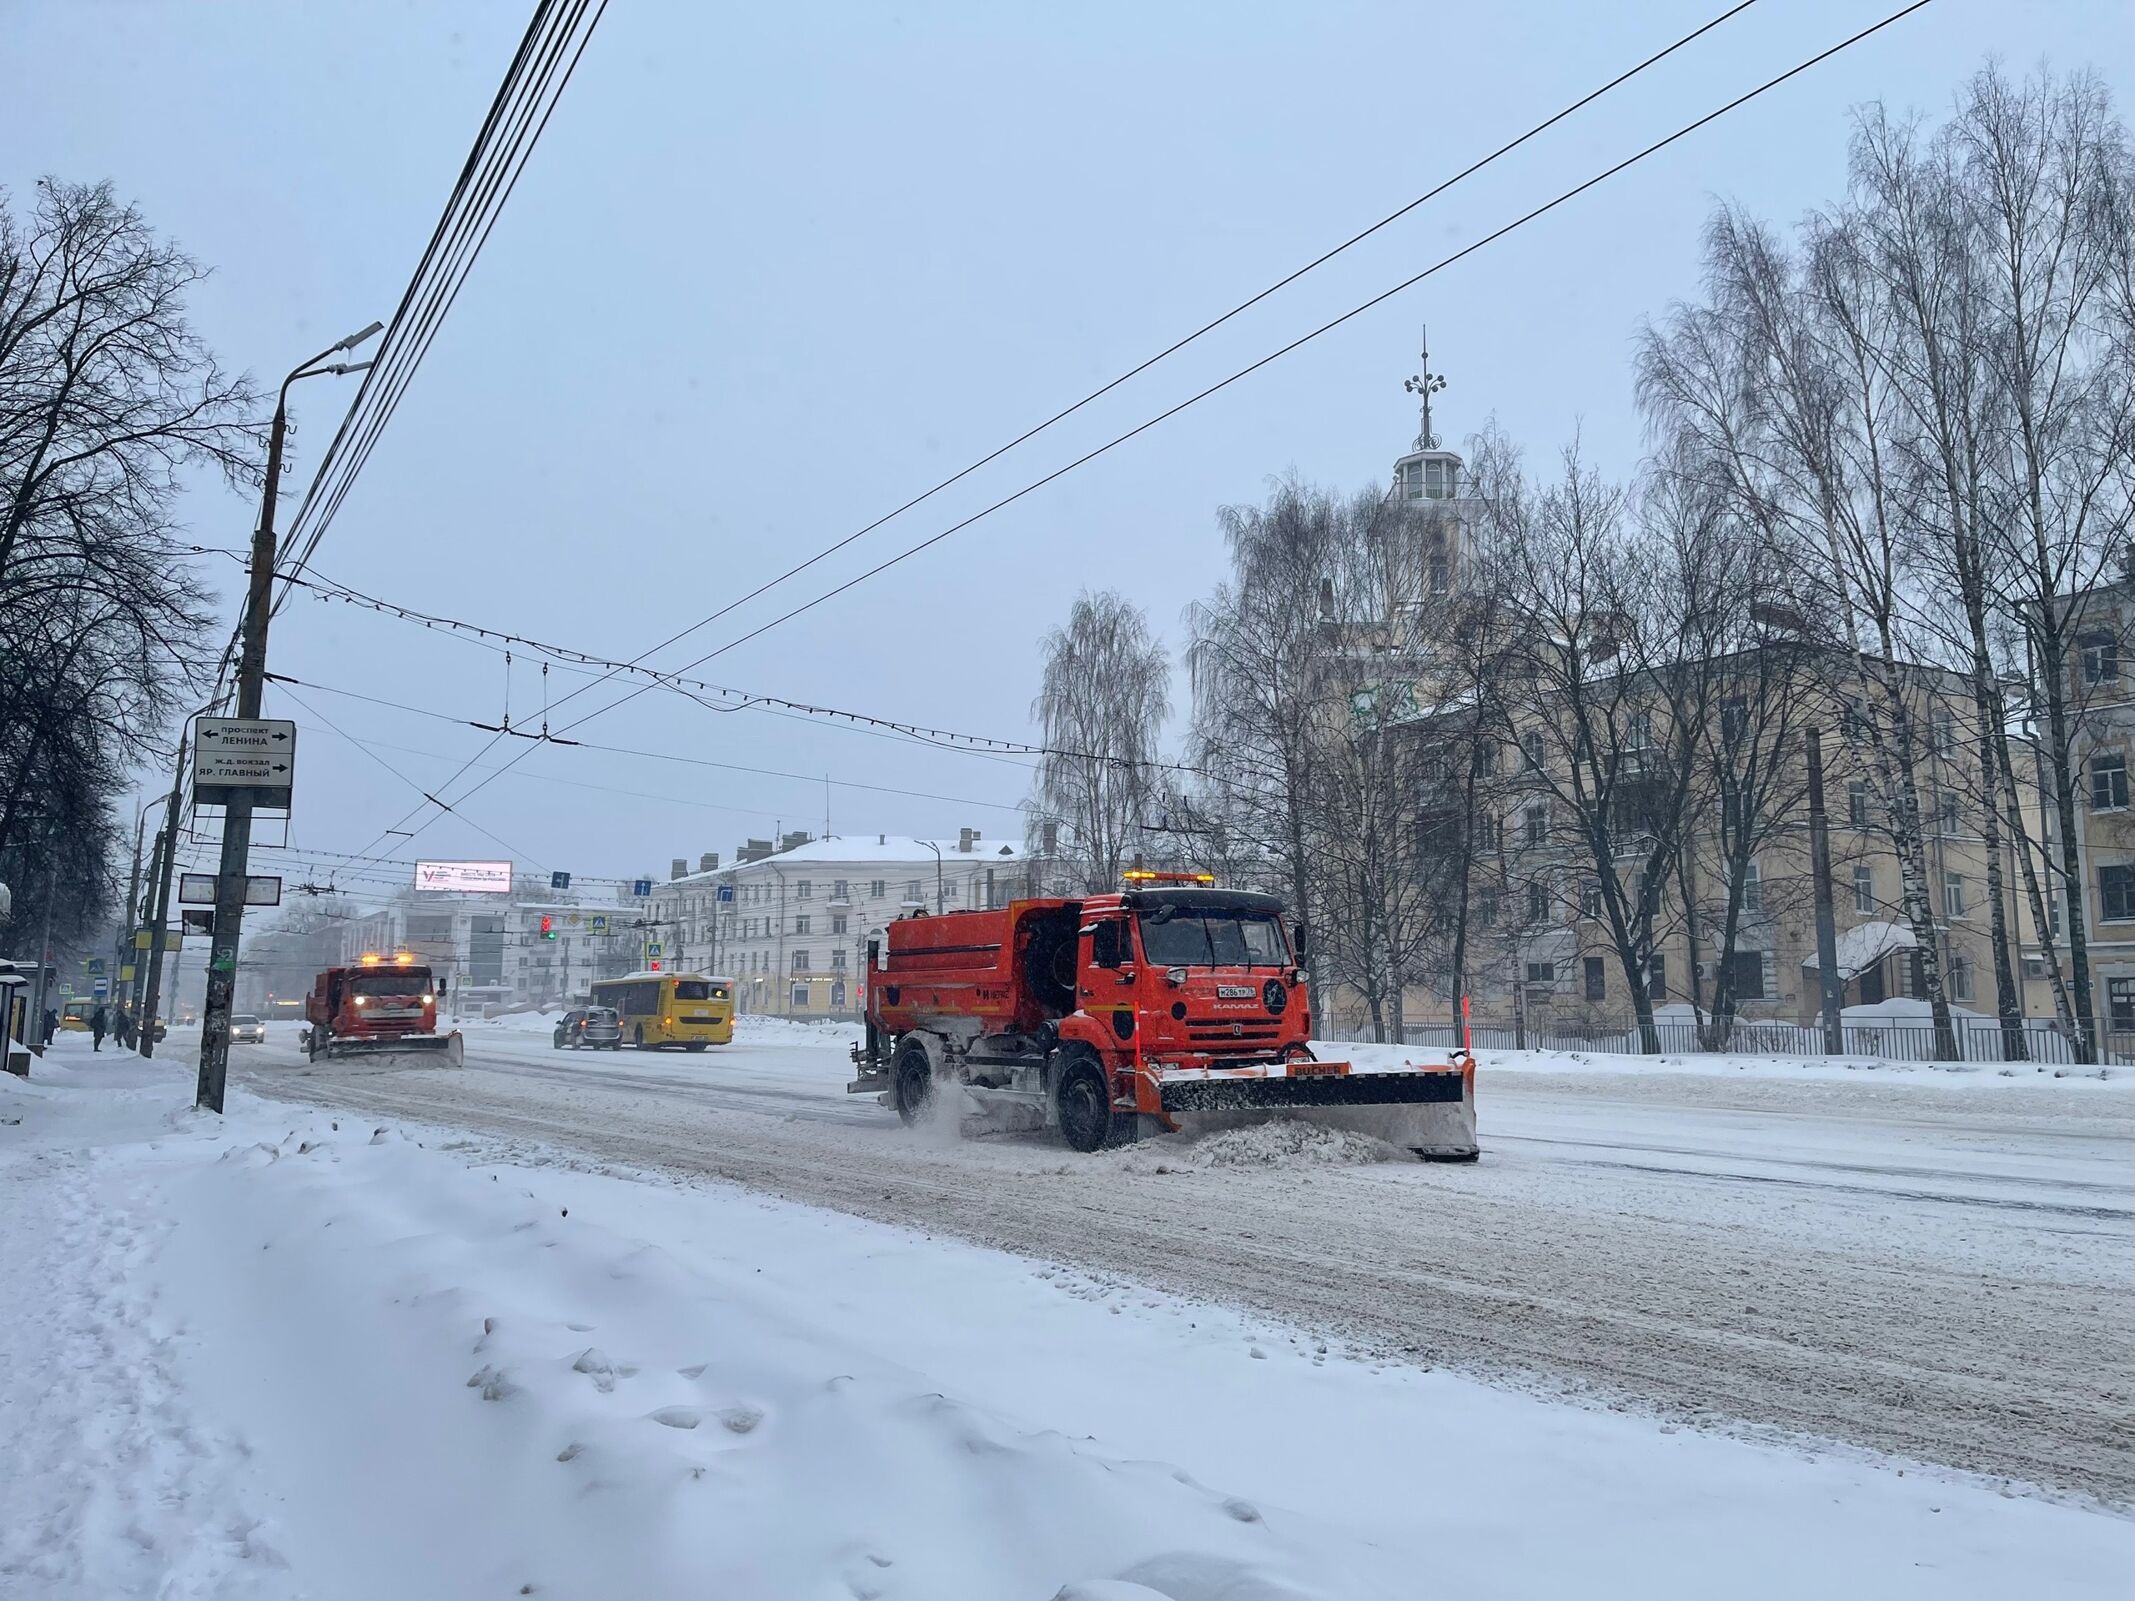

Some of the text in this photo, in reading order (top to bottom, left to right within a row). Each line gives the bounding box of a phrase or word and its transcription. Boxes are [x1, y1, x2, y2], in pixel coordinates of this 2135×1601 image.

[221, 737, 268, 746] ЛЕНИНА
[199, 768, 270, 777] ЯР. ГЛАВНЫЙ
[1295, 1065, 1341, 1076] BUCHER
